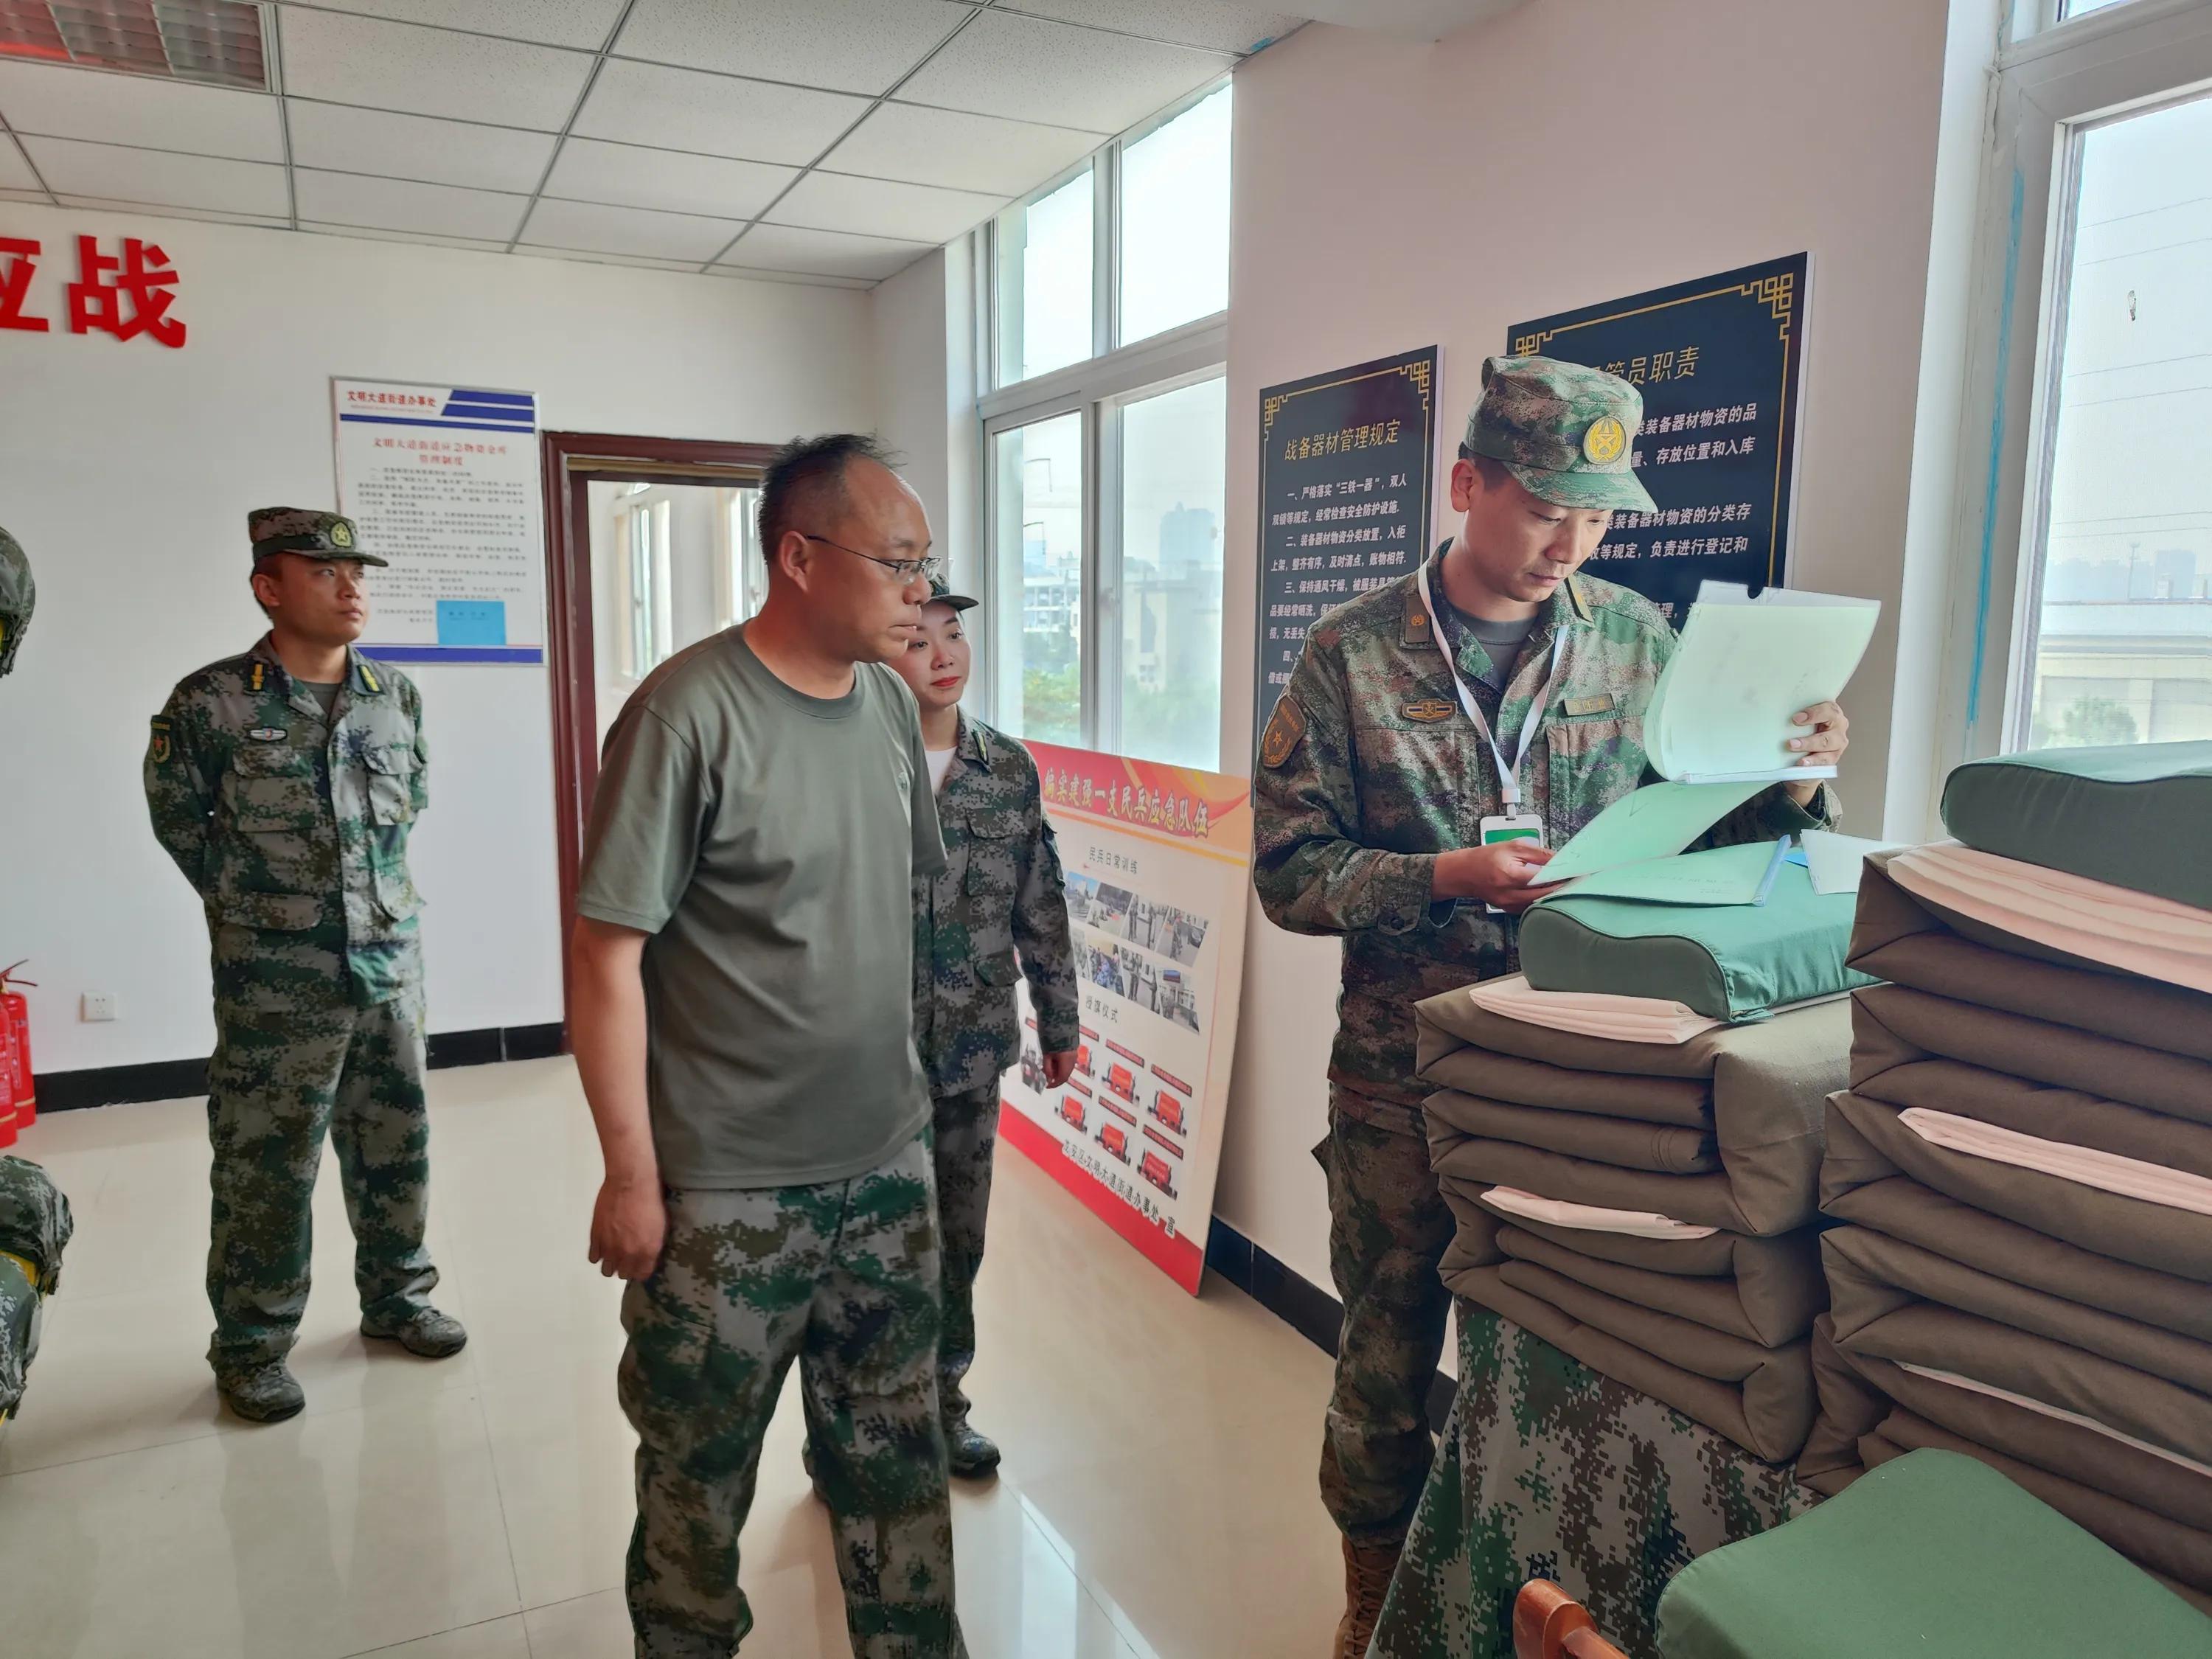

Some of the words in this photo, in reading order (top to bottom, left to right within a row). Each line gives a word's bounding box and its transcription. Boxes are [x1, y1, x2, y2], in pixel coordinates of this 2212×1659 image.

[1593, 347, 1700, 385] 管员职责
[347, 390, 437, 407] 文明大道街道办事处
[1284, 419, 1400, 461] 战备器材管理规定
[1089, 846, 1138, 874] 民兵日常训练
